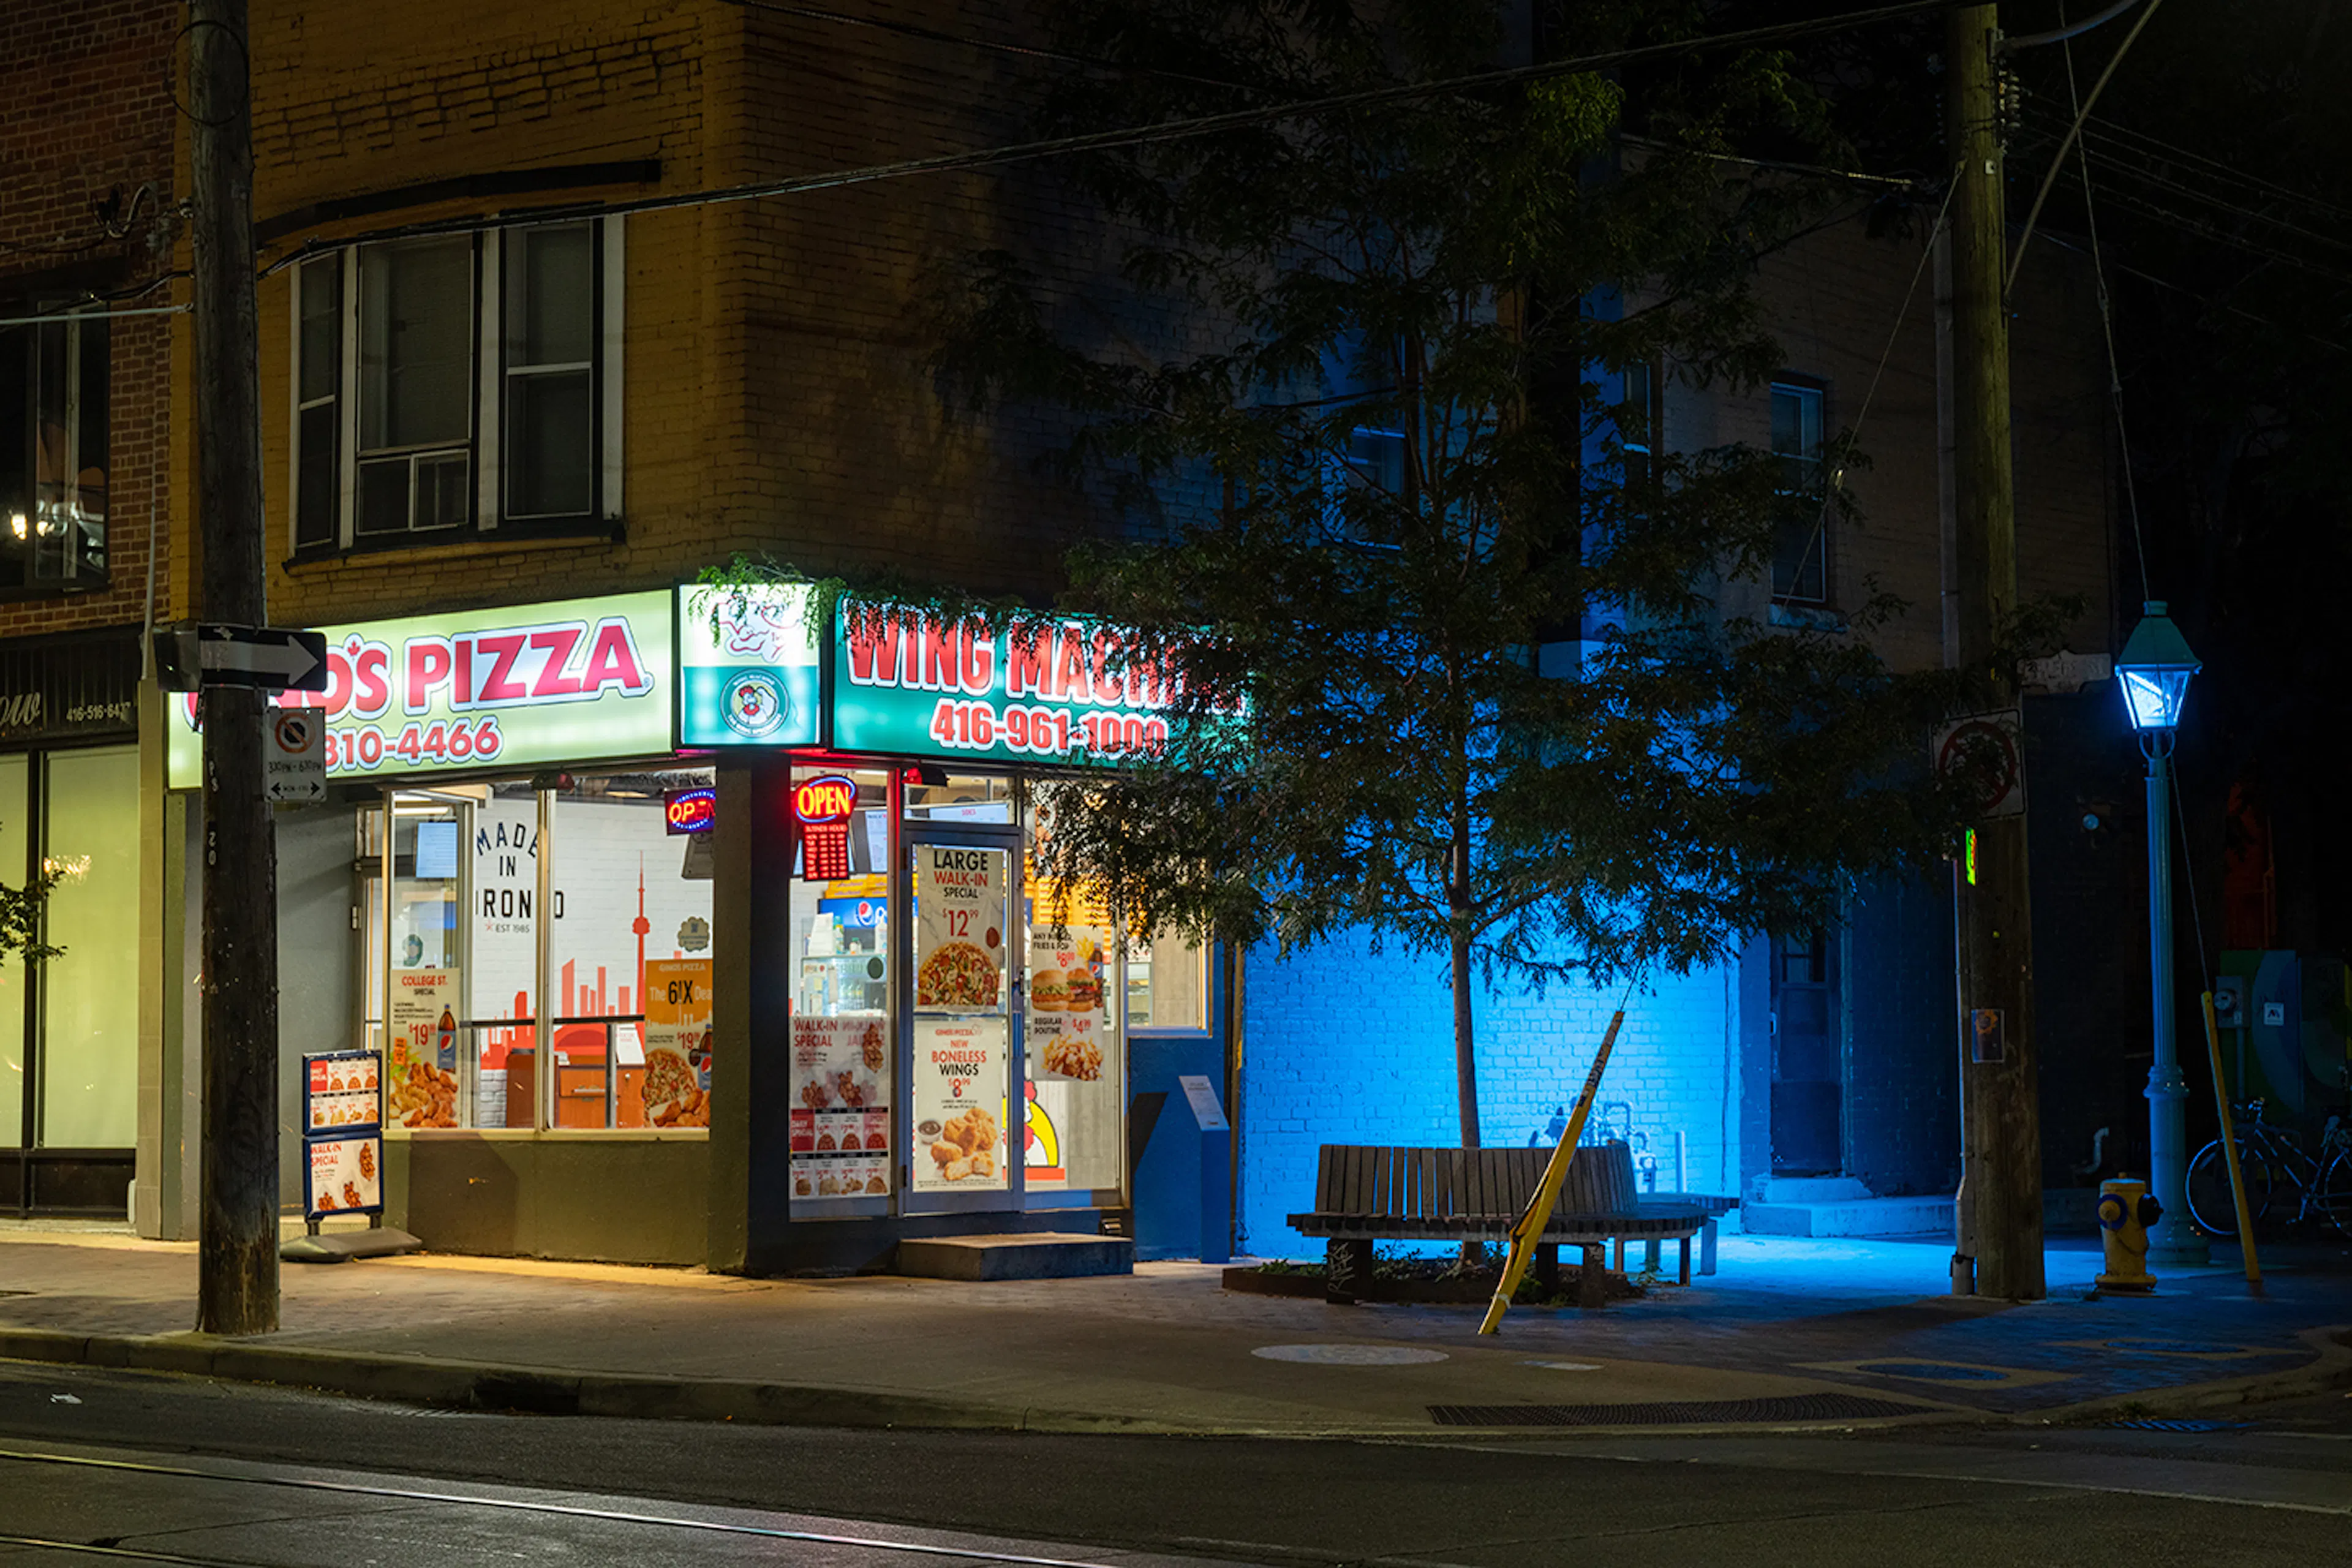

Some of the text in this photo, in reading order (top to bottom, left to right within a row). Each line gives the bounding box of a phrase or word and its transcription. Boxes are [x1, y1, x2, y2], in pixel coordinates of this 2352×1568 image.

[407, 623, 644, 709] PIZZA
[847, 603, 1246, 715] WING MACHI
[933, 703, 1164, 758] 416-961-1000
[797, 786, 851, 816] OPEN
[668, 799, 716, 823] OPEN
[477, 822, 538, 858] MADE
[500, 856, 515, 876] IN
[933, 850, 989, 871] LARGE
[933, 871, 989, 888] WALK-IN
[943, 887, 979, 899] SPECIAL
[401, 974, 435, 987] COLLEGE
[649, 987, 666, 1001] The
[695, 986, 712, 1001] Dea
[793, 1019, 839, 1032] WALK-IN
[794, 1034, 832, 1047] SPECIAL
[950, 1039, 969, 1049] NEW
[931, 1050, 987, 1063] BONELESS
[939, 1063, 979, 1076] WINGS
[311, 1142, 342, 1155] WALK-IN
[311, 1155, 339, 1168] SPECIAL
